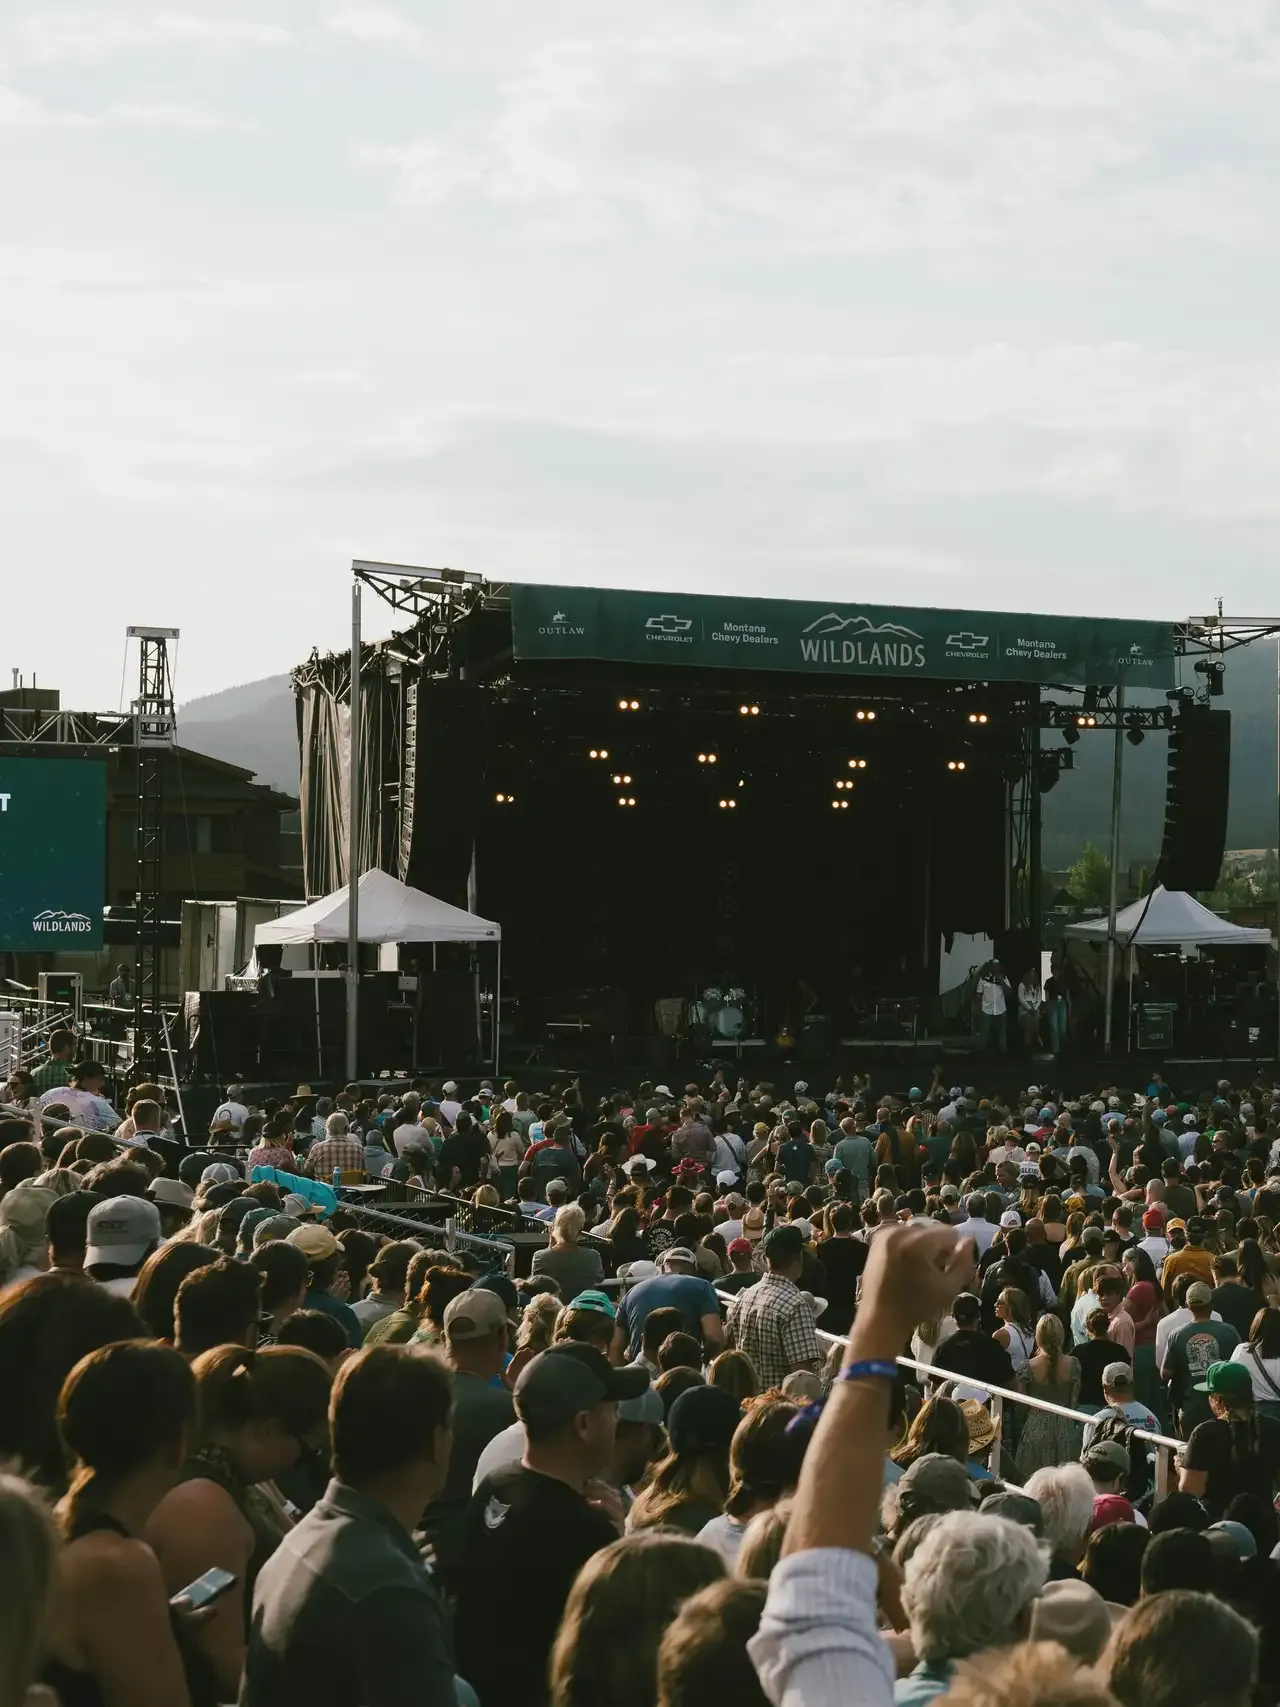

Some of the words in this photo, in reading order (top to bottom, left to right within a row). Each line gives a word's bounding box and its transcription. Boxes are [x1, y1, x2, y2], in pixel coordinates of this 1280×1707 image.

[538, 627, 585, 635] OUTLAW
[723, 622, 766, 633] Montana
[645, 634, 693, 643] CHEVROLET
[711, 632, 741, 644] Chevy
[742, 633, 779, 644] Dealers
[1017, 638, 1056, 649] Montana
[800, 639, 926, 667] WILDLANDS
[945, 651, 989, 659] CHEVROLET
[1006, 648, 1032, 659] Chevy
[1033, 649, 1067, 659] Dealers
[1118, 657, 1154, 666] OUTLAW
[32, 921, 92, 932] WILDLANDS
